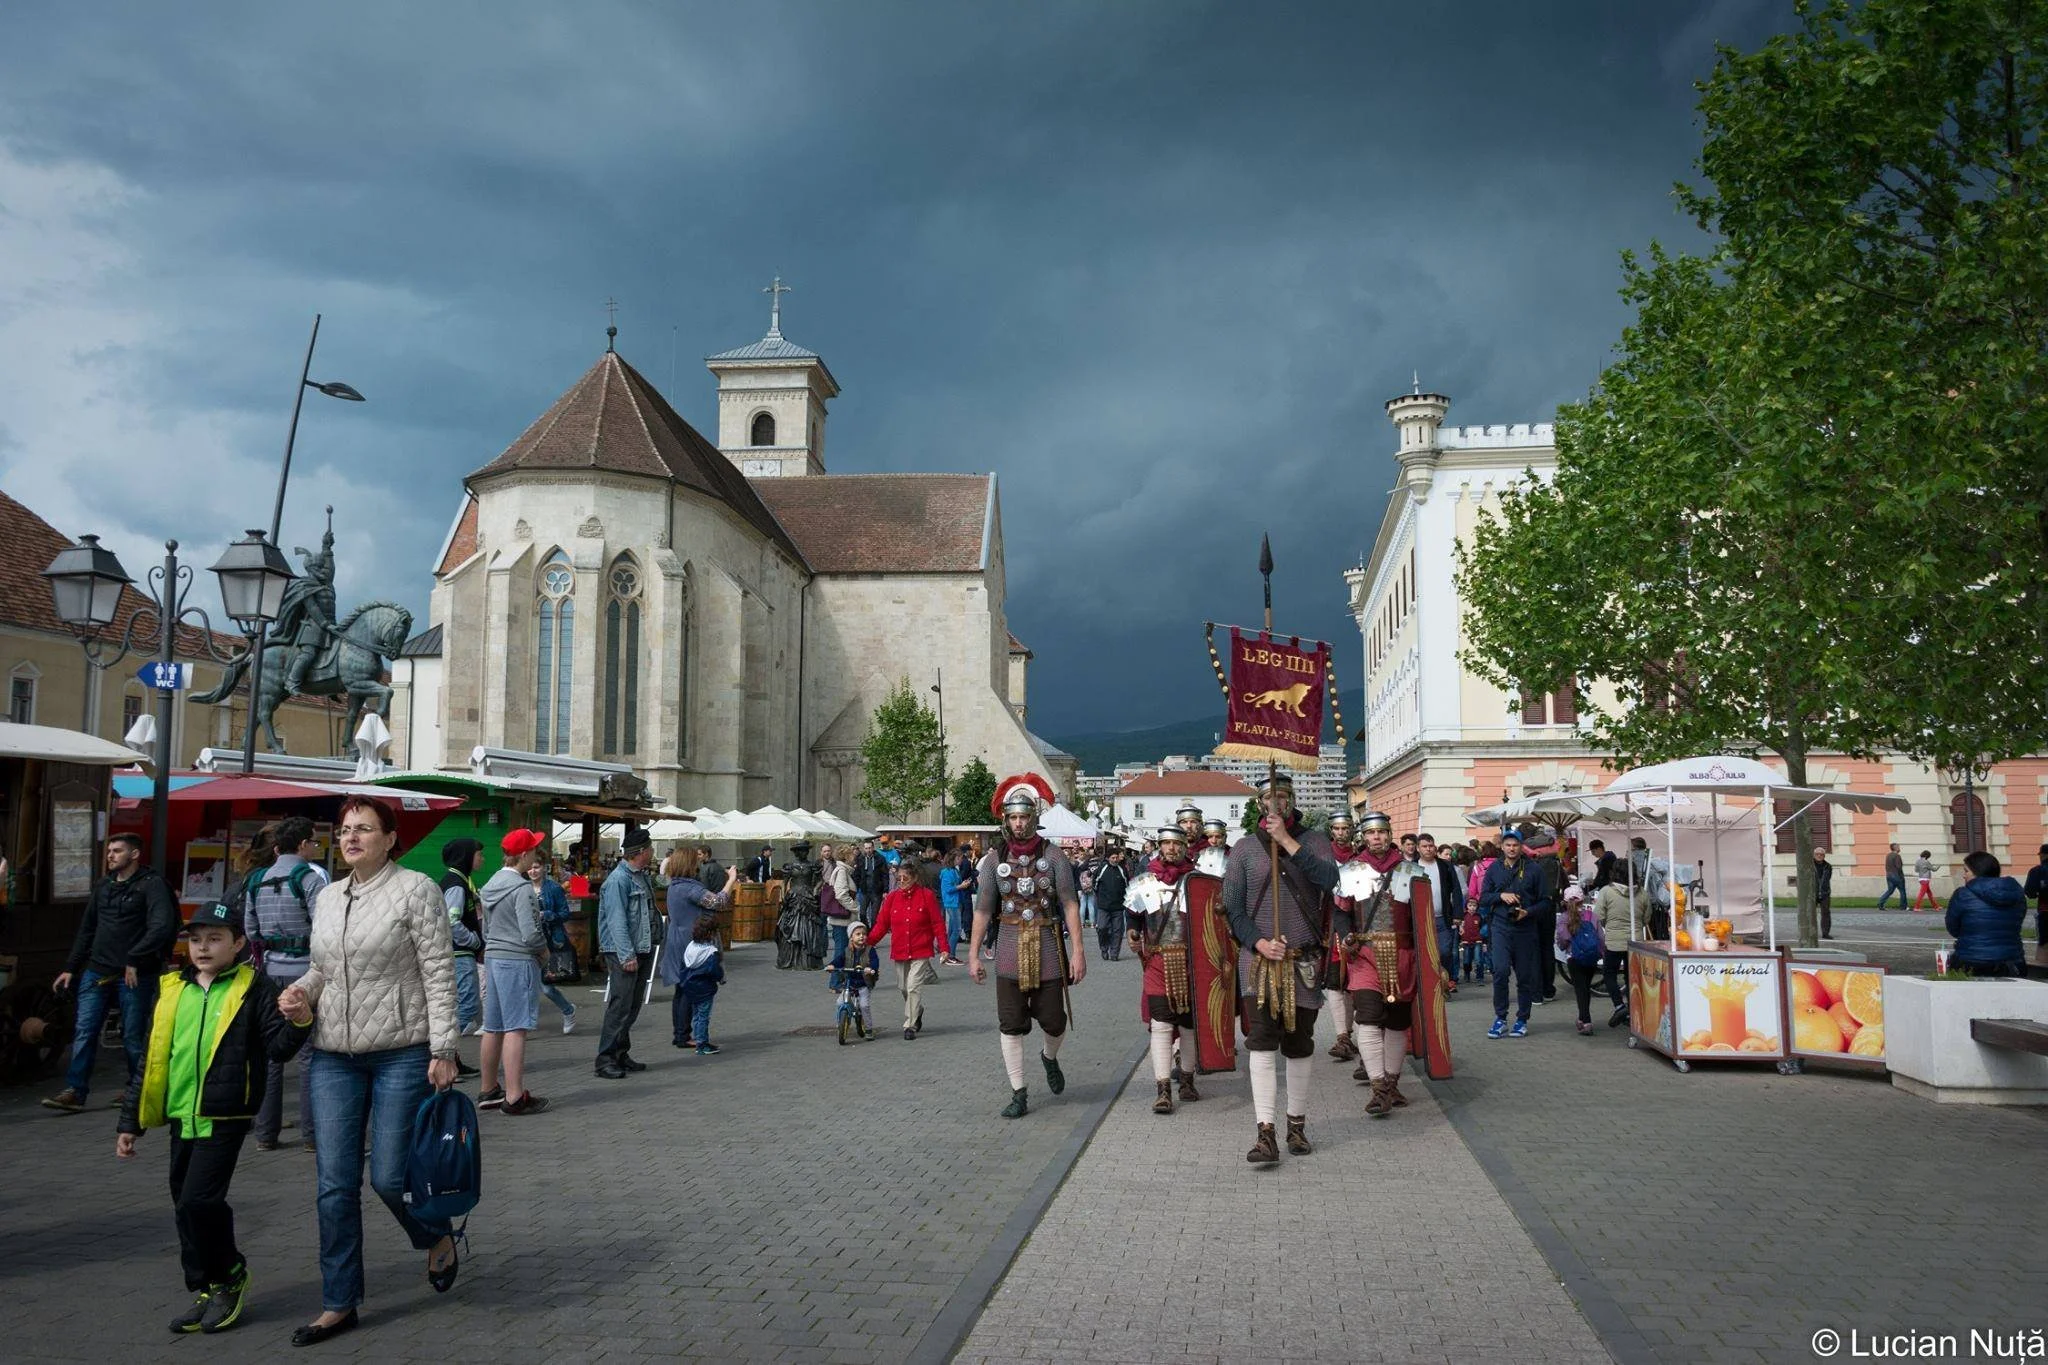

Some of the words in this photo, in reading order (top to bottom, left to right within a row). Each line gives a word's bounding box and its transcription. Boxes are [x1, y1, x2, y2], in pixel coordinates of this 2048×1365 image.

[1242, 648, 1282, 667] LEG
[155, 680, 175, 688] WC
[1680, 964, 1716, 976] 100%
[1719, 963, 1771, 975] natural
